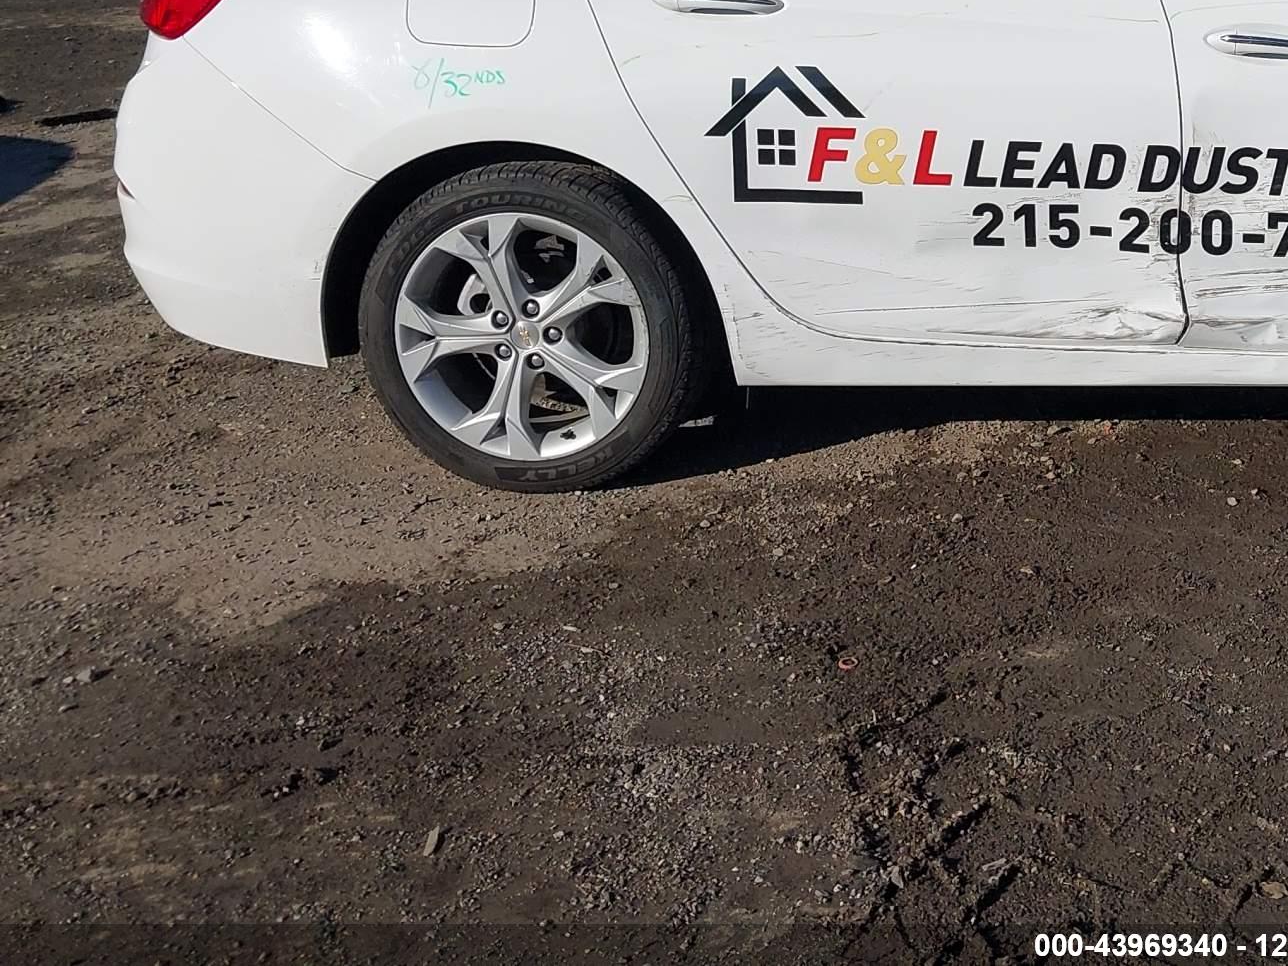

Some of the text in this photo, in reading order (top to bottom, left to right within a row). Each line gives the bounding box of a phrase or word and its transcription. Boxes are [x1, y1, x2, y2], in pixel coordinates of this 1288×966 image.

[806, 126, 953, 186] F&L
[962, 139, 1128, 190] LEAD
[454, 192, 588, 221] TOURING
[518, 445, 614, 482] KELLY
